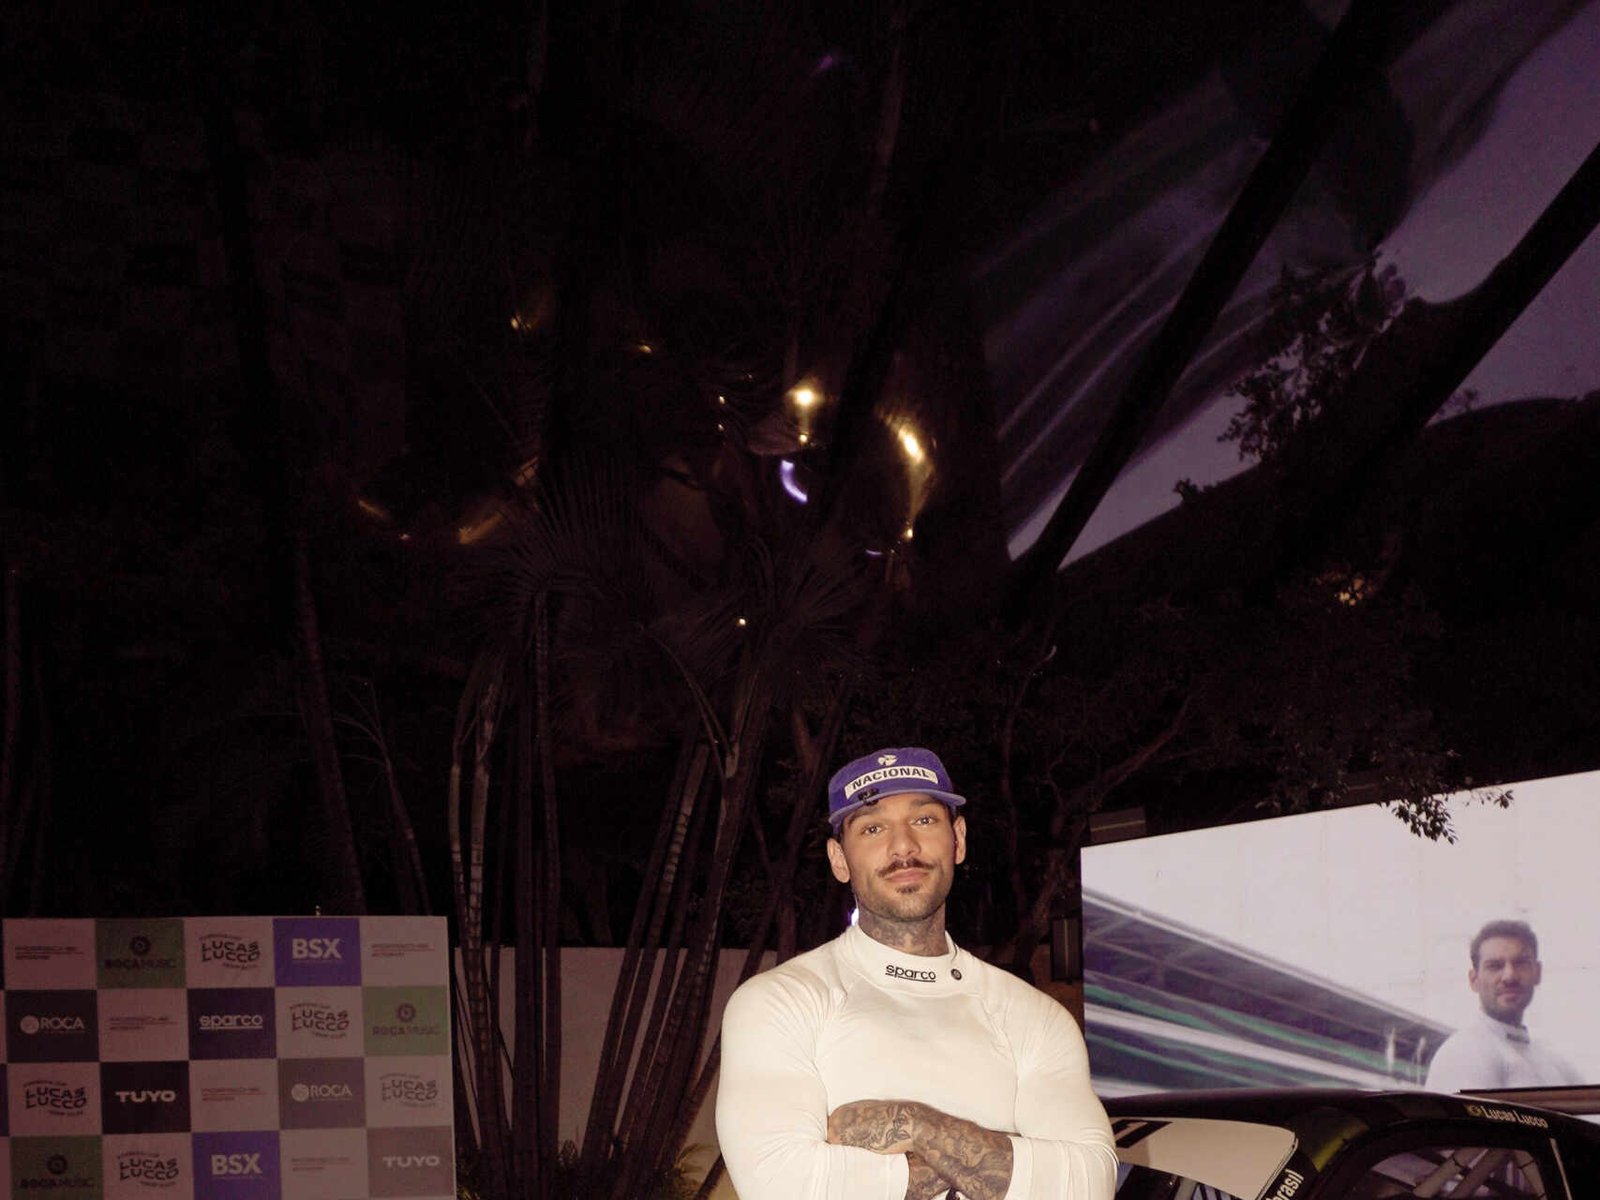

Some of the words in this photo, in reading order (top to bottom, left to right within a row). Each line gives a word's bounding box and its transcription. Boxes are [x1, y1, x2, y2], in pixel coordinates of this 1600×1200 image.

[851, 767, 930, 790] NACIONAL
[200, 941, 258, 952] LUCAS
[291, 938, 342, 960] BSX
[200, 951, 260, 962] LUCCO
[885, 964, 937, 981] sparco
[292, 1008, 349, 1021] LUCAS
[40, 1016, 85, 1030] ROCA
[199, 1013, 264, 1030] sparco
[292, 1020, 349, 1032] LUCCO
[26, 1087, 85, 1099] LUCAS
[115, 1090, 177, 1103] TUYO
[308, 1084, 352, 1098] ROCA
[26, 1098, 86, 1110] LUCCO
[120, 1158, 177, 1170] LUCAS
[211, 1153, 263, 1175] BSX
[382, 1155, 441, 1168] TUYO
[120, 1169, 179, 1181] LUCCO
